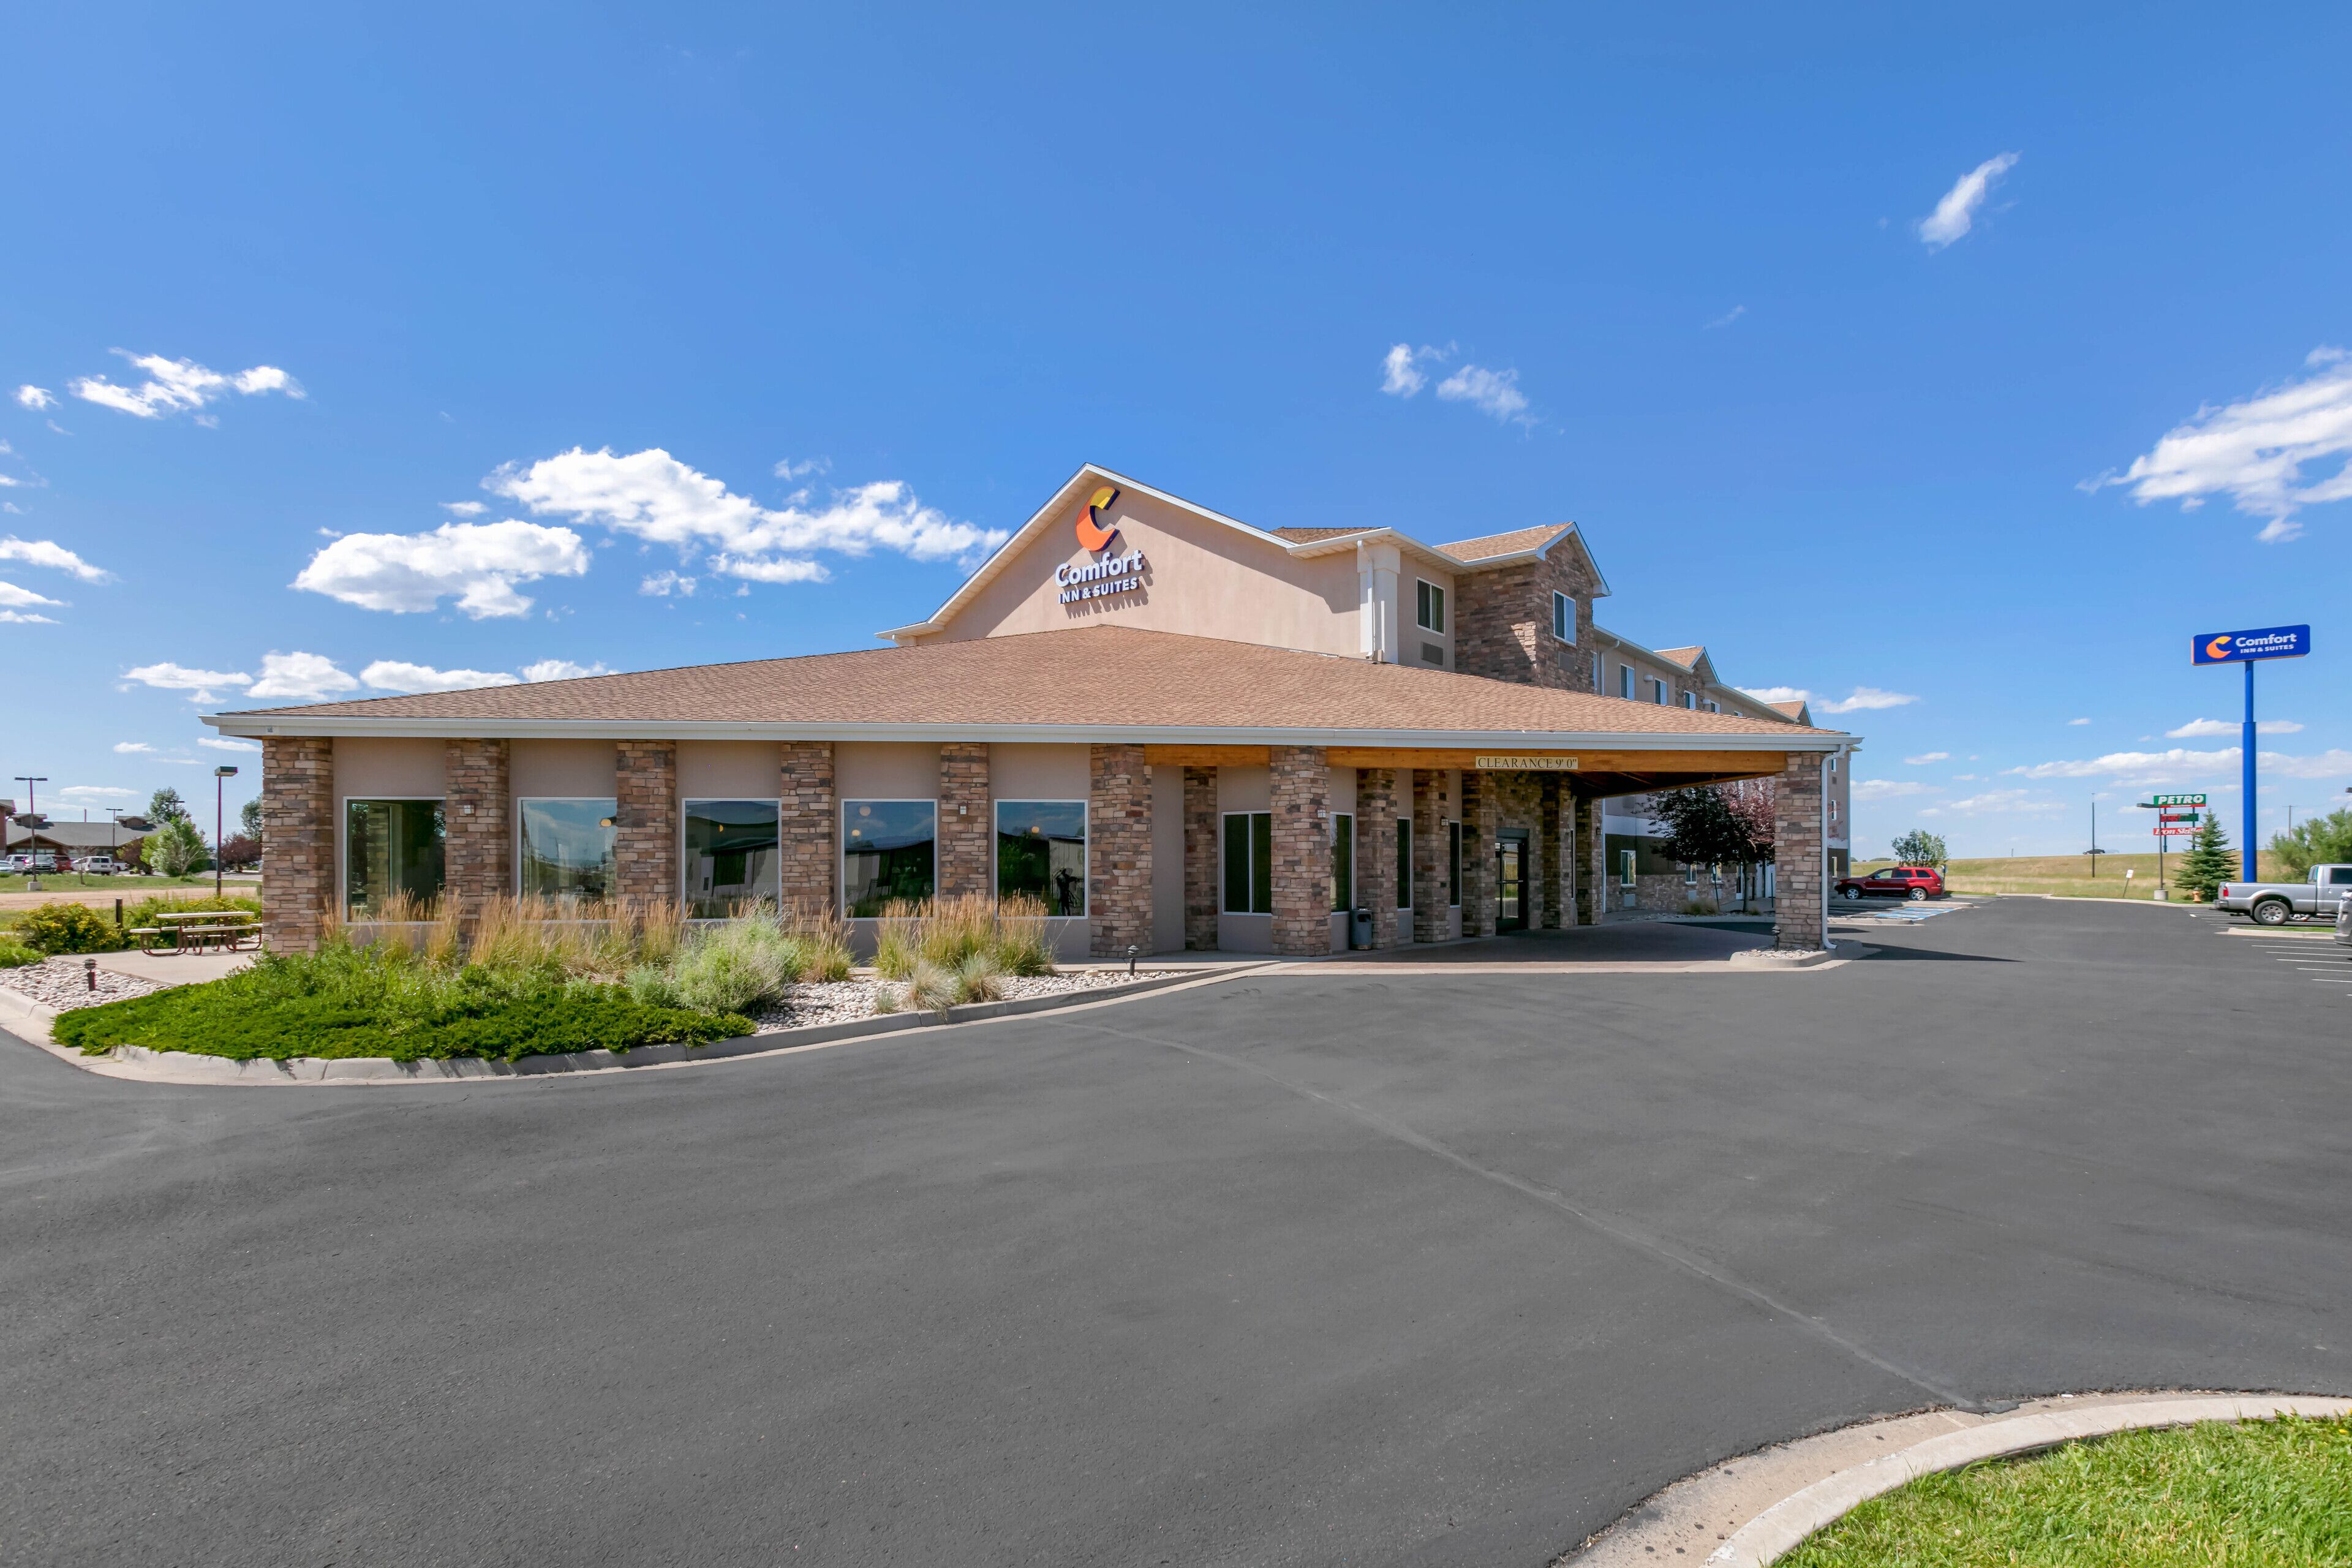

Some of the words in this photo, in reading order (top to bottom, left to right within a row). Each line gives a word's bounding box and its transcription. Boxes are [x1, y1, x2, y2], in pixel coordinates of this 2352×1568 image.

[1055, 549, 1144, 587] Comfort
[1058, 590, 1080, 604] INN
[1082, 587, 1091, 600] &
[1093, 577, 1139, 597] SUITES
[2236, 633, 2297, 647] Comfort
[1478, 757, 1553, 768] CLEARANCE
[2158, 795, 2204, 804] PETRO
